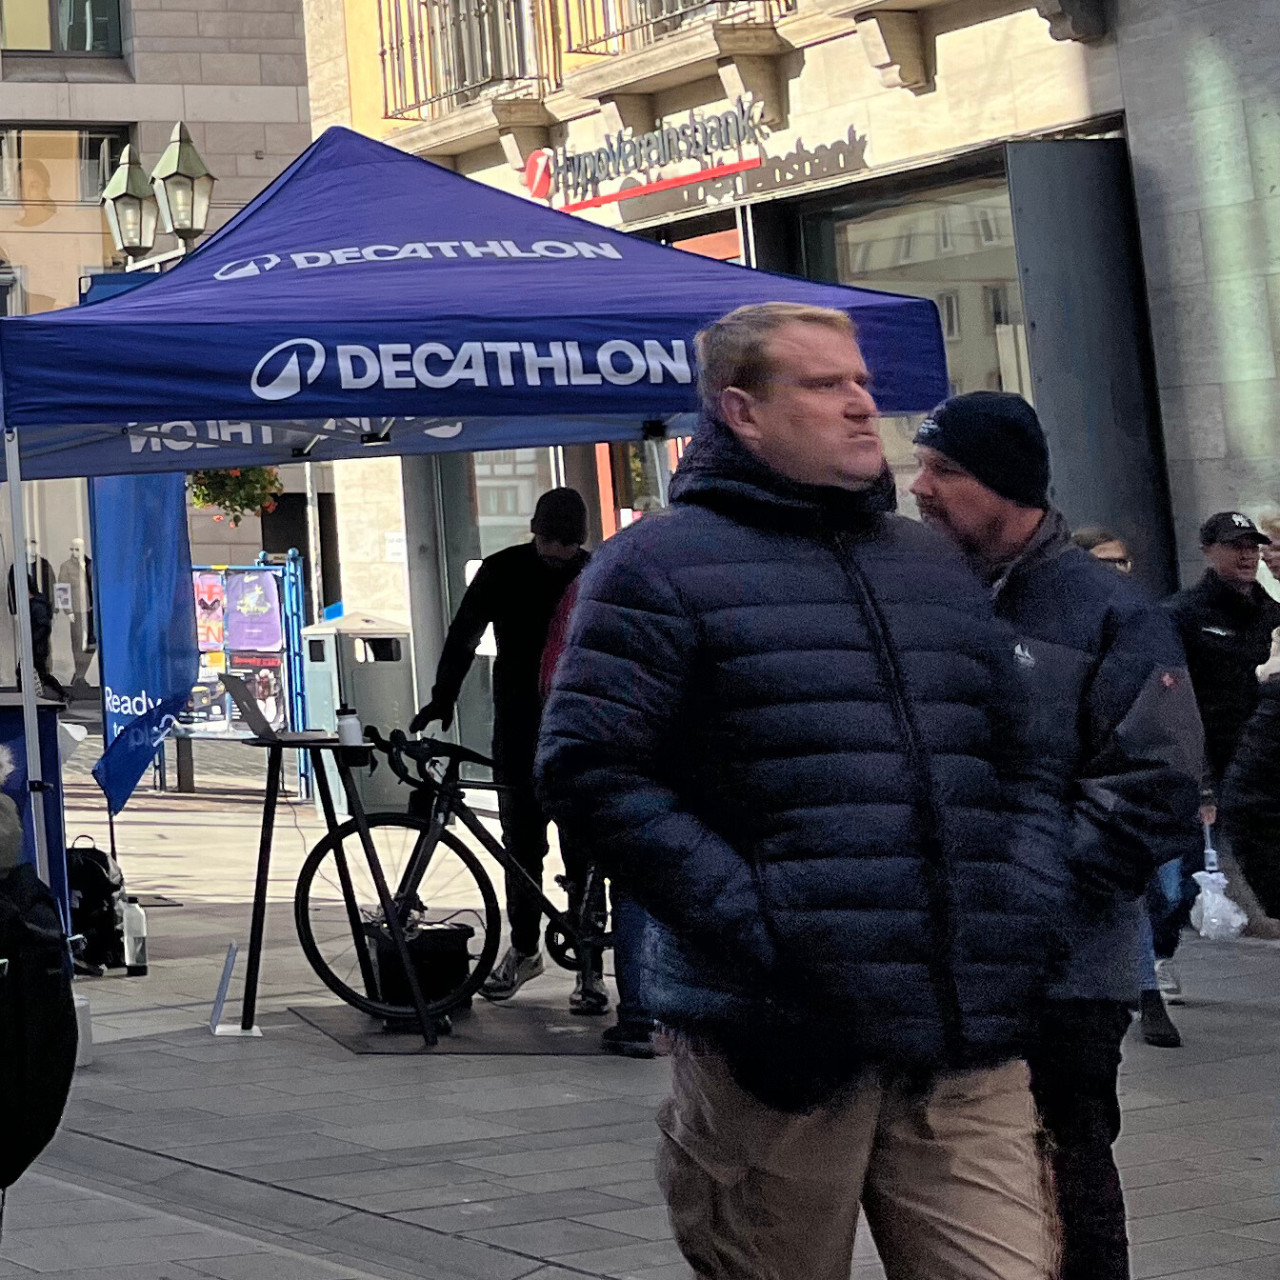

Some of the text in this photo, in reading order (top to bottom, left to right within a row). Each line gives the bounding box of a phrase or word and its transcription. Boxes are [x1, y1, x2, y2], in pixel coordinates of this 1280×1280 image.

[552, 94, 758, 200] HypoVereinsbank
[289, 240, 624, 270] DECATHLON
[336, 338, 692, 390] DECATHLON
